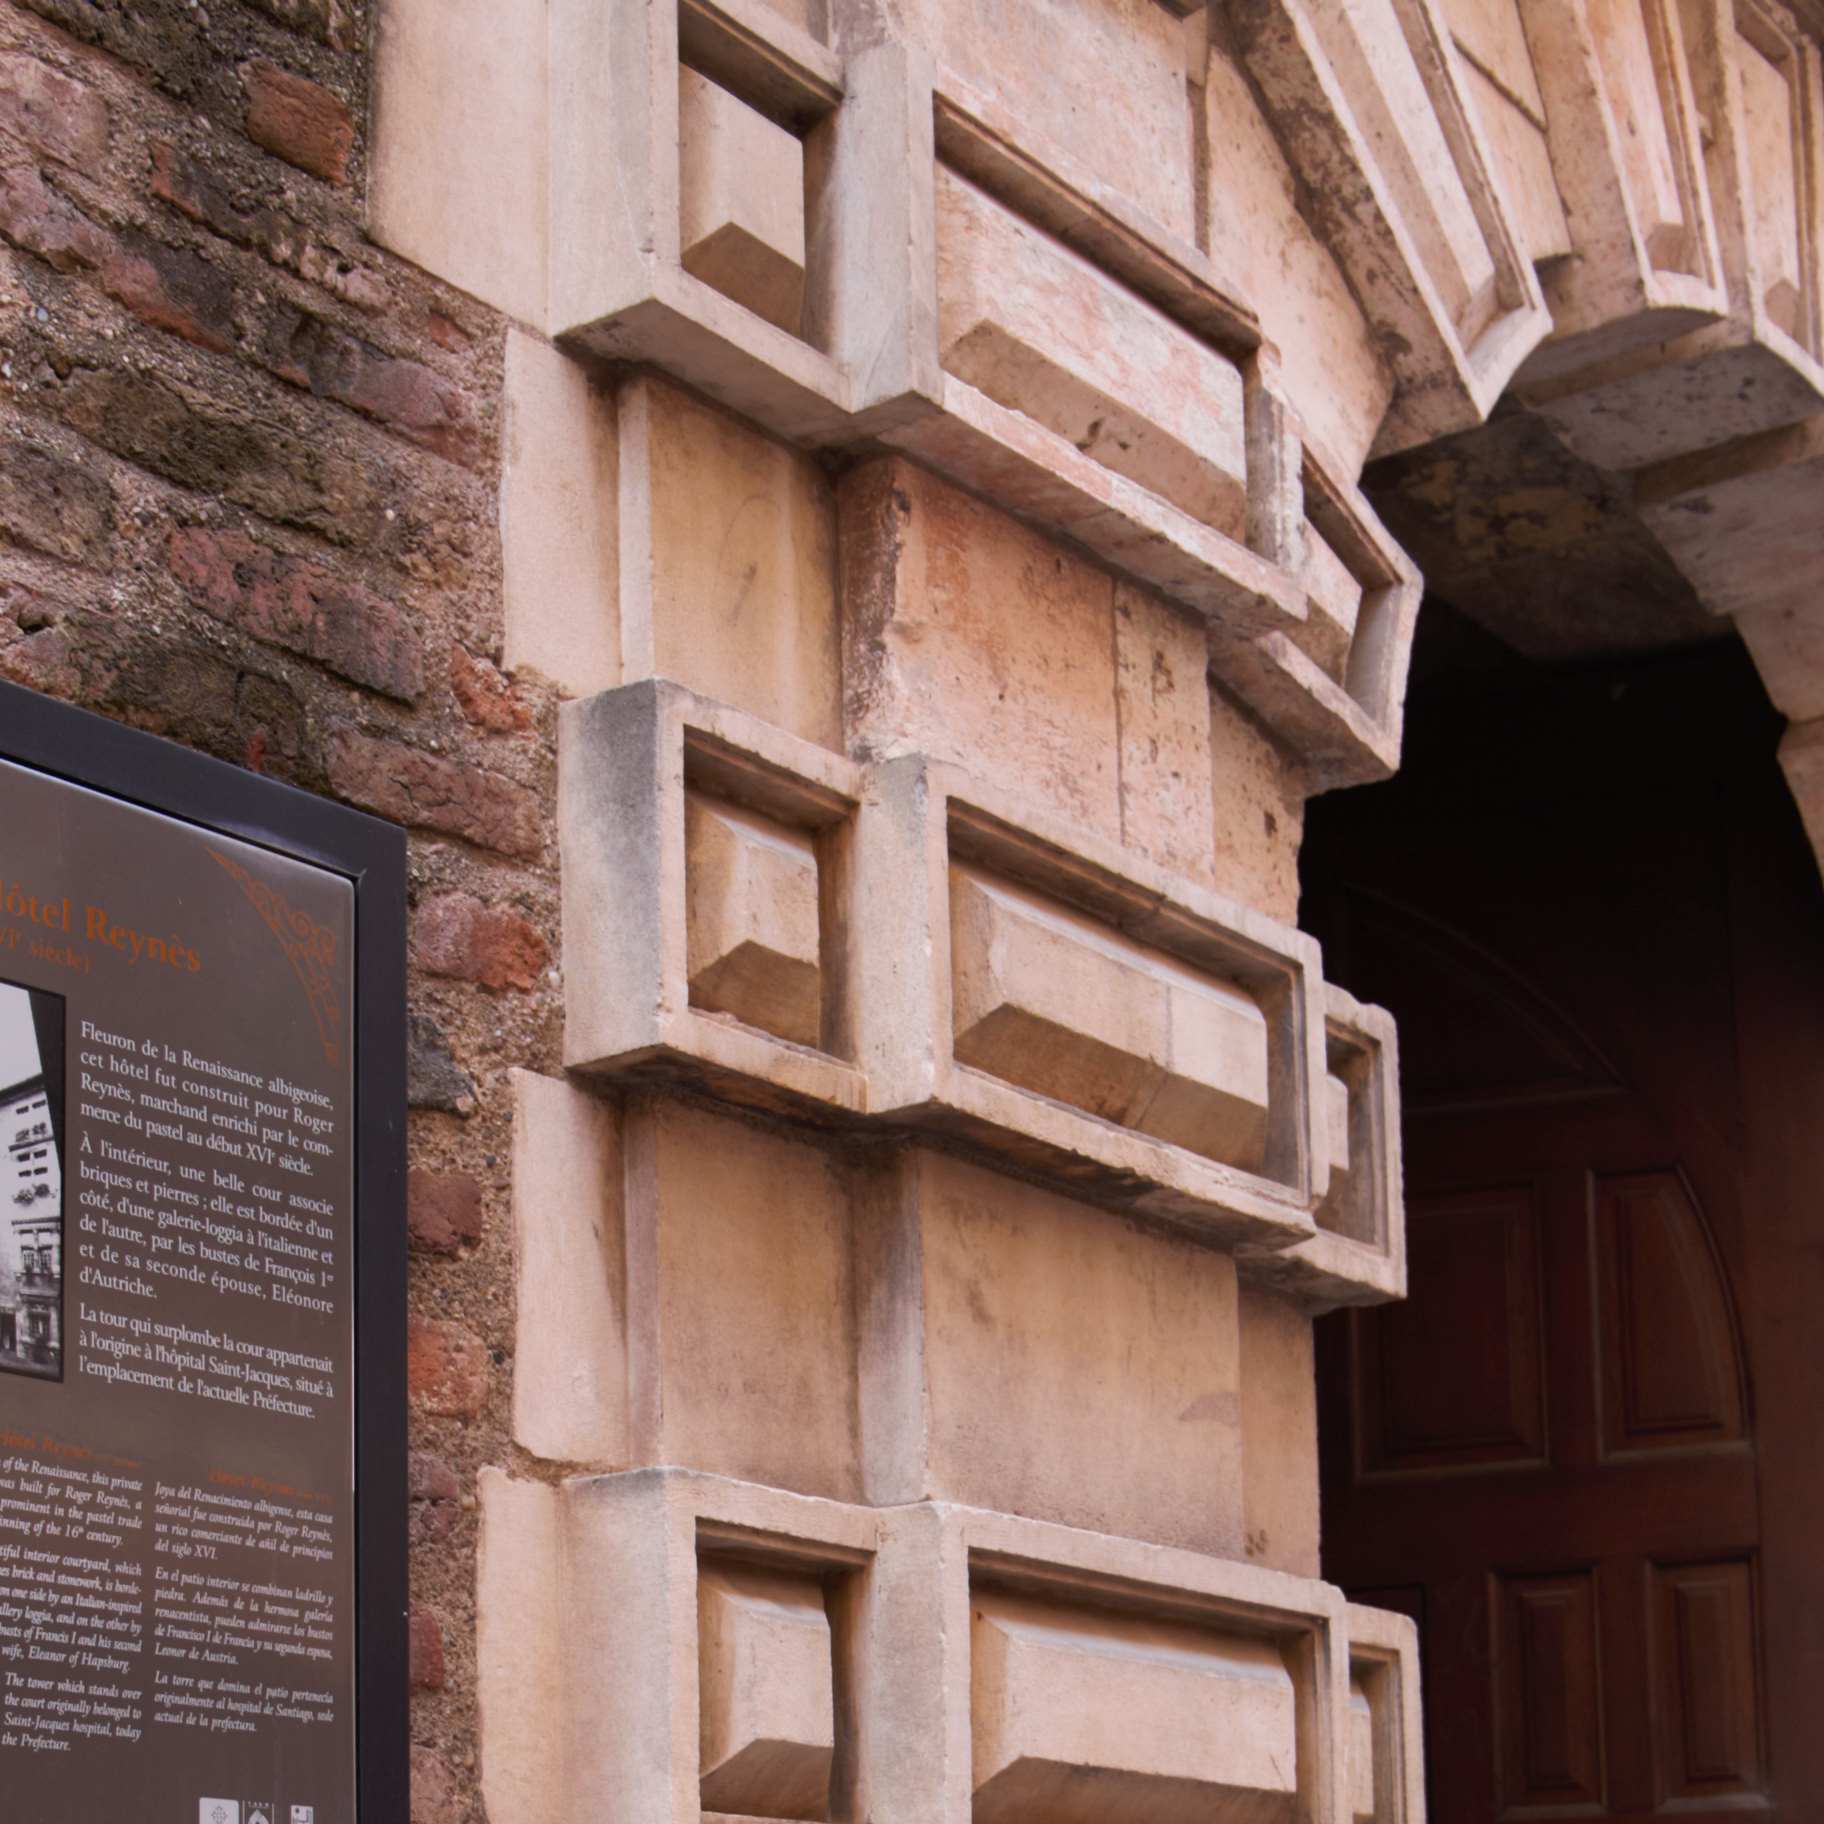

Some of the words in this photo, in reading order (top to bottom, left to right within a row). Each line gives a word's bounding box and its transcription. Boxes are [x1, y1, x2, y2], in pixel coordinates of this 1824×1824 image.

[84, 905, 202, 974] Reynès
[80, 1053, 104, 1071] cet
[110, 1055, 149, 1084] hôtel
[155, 1068, 177, 1091] fut
[182, 1081, 249, 1111] construit
[254, 1101, 289, 1122] pour
[293, 1106, 334, 1136] Roger
[81, 1021, 136, 1054] Fleuron
[141, 1038, 159, 1060] de
[164, 1044, 177, 1065] la
[182, 1049, 263, 1088] Renaissance
[268, 1074, 334, 1110] albigeoise,
[80, 1104, 121, 1126] merce
[124, 1109, 143, 1132] du
[146, 1121, 184, 1143] pastel
[186, 1132, 203, 1148] au
[206, 1131, 243, 1158] début
[278, 1151, 313, 1176] siècle.
[81, 1072, 135, 1107] Reynès,
[140, 1094, 208, 1124] marchand
[212, 1113, 258, 1137] enrichi
[262, 1127, 284, 1145] par
[288, 1128, 299, 1148] le
[303, 1137, 333, 1156] com-
[80, 1131, 93, 1156] À
[100, 1140, 172, 1178] l'intérieur,
[179, 1166, 206, 1184] une
[212, 1169, 245, 1194] belle
[252, 1184, 283, 1204] cour
[289, 1194, 334, 1217] associe
[80, 1159, 133, 1190] briques
[135, 1178, 150, 1194] et
[153, 1180, 200, 1207] pierres
[210, 1194, 234, 1215] elle
[236, 1204, 256, 1221] est
[258, 1204, 303, 1233] bordée
[305, 1216, 334, 1241] d'un
[79, 1188, 114, 1215] côté,
[116, 1195, 155, 1222] d'une
[157, 1209, 244, 1246] galerie-loggia
[246, 1227, 255, 1246] à
[257, 1230, 319, 1262] l'italienne
[321, 1250, 333, 1266] et
[79, 1211, 97, 1233] de
[101, 1216, 147, 1247] l'autre,
[151, 1234, 174, 1253] par
[178, 1235, 196, 1256] les
[199, 1240, 241, 1267] bustes
[244, 1251, 261, 1272] de
[264, 1256, 316, 1286] François
[79, 1243, 95, 1259] et
[100, 1243, 119, 1264] de
[124, 1254, 141, 1269] sa
[146, 1258, 207, 1284] seconde
[211, 1267, 267, 1300] épouse,
[272, 1281, 334, 1312] Eléonore
[79, 1264, 157, 1299] d'Autriche.
[79, 1328, 88, 1347] à
[90, 1330, 142, 1359] l'origine
[144, 1342, 153, 1361] à
[155, 1344, 206, 1373] l'hôpital
[208, 1355, 293, 1393] Saint-Jacques,
[296, 1374, 324, 1397] situé
[326, 1380, 334, 1399] à
[80, 1301, 97, 1322] La
[99, 1308, 128, 1329] tour
[129, 1316, 152, 1336] qui
[154, 1323, 221, 1350] surplombe
[223, 1333, 235, 1353] la
[236, 1341, 265, 1359] cour
[266, 1348, 333, 1375] appartenait
[79, 1353, 175, 1390] l'emplacement
[177, 1374, 194, 1394] de
[197, 1378, 250, 1406] l'actuelle
[252, 1389, 315, 1420] Préfecture.
[2, 1457, 14, 1475] of
[14, 1456, 29, 1472] the
[31, 1460, 89, 1484] Renaissance,
[92, 1470, 109, 1485] this
[110, 1474, 142, 1491] private
[19, 1477, 43, 1494] built
[46, 1481, 60, 1499] for
[65, 1484, 92, 1504] Roger
[96, 1489, 130, 1510] Reynès,
[135, 1500, 142, 1510] a
[0, 1497, 50, 1515] prominent
[54, 1502, 64, 1517] in
[68, 1504, 83, 1520] the
[86, 1511, 114, 1525] pastel
[117, 1514, 142, 1529] trade
[33, 1520, 45, 1537] of
[44, 1521, 61, 1536] the
[86, 1531, 122, 1548] century.
